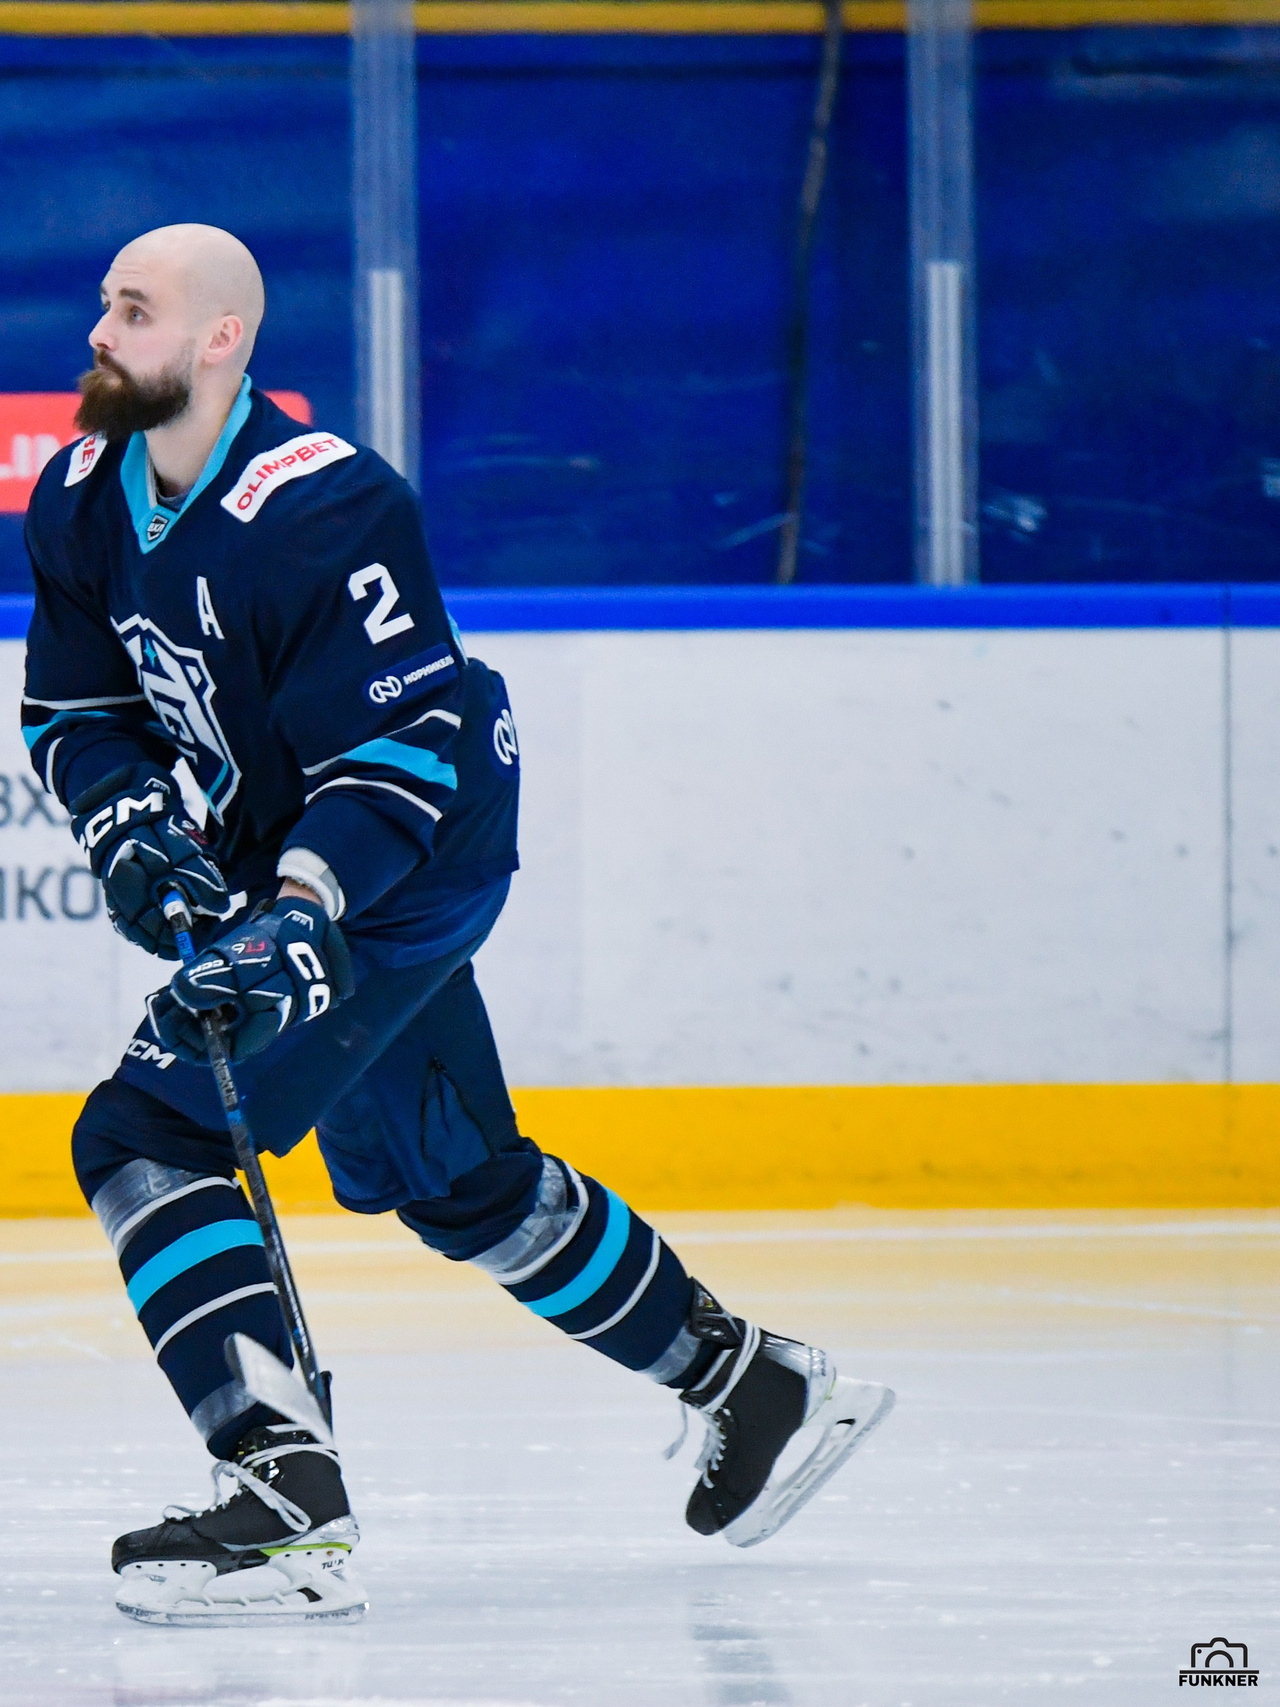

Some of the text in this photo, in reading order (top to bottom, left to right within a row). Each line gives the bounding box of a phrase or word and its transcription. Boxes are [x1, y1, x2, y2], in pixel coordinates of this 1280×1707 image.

[236, 436, 340, 511] OLIMPBET
[195, 575, 226, 640] A
[347, 561, 416, 645] 2
[80, 791, 164, 853] CM
[286, 941, 331, 1022] CC
[127, 1038, 177, 1070] CM
